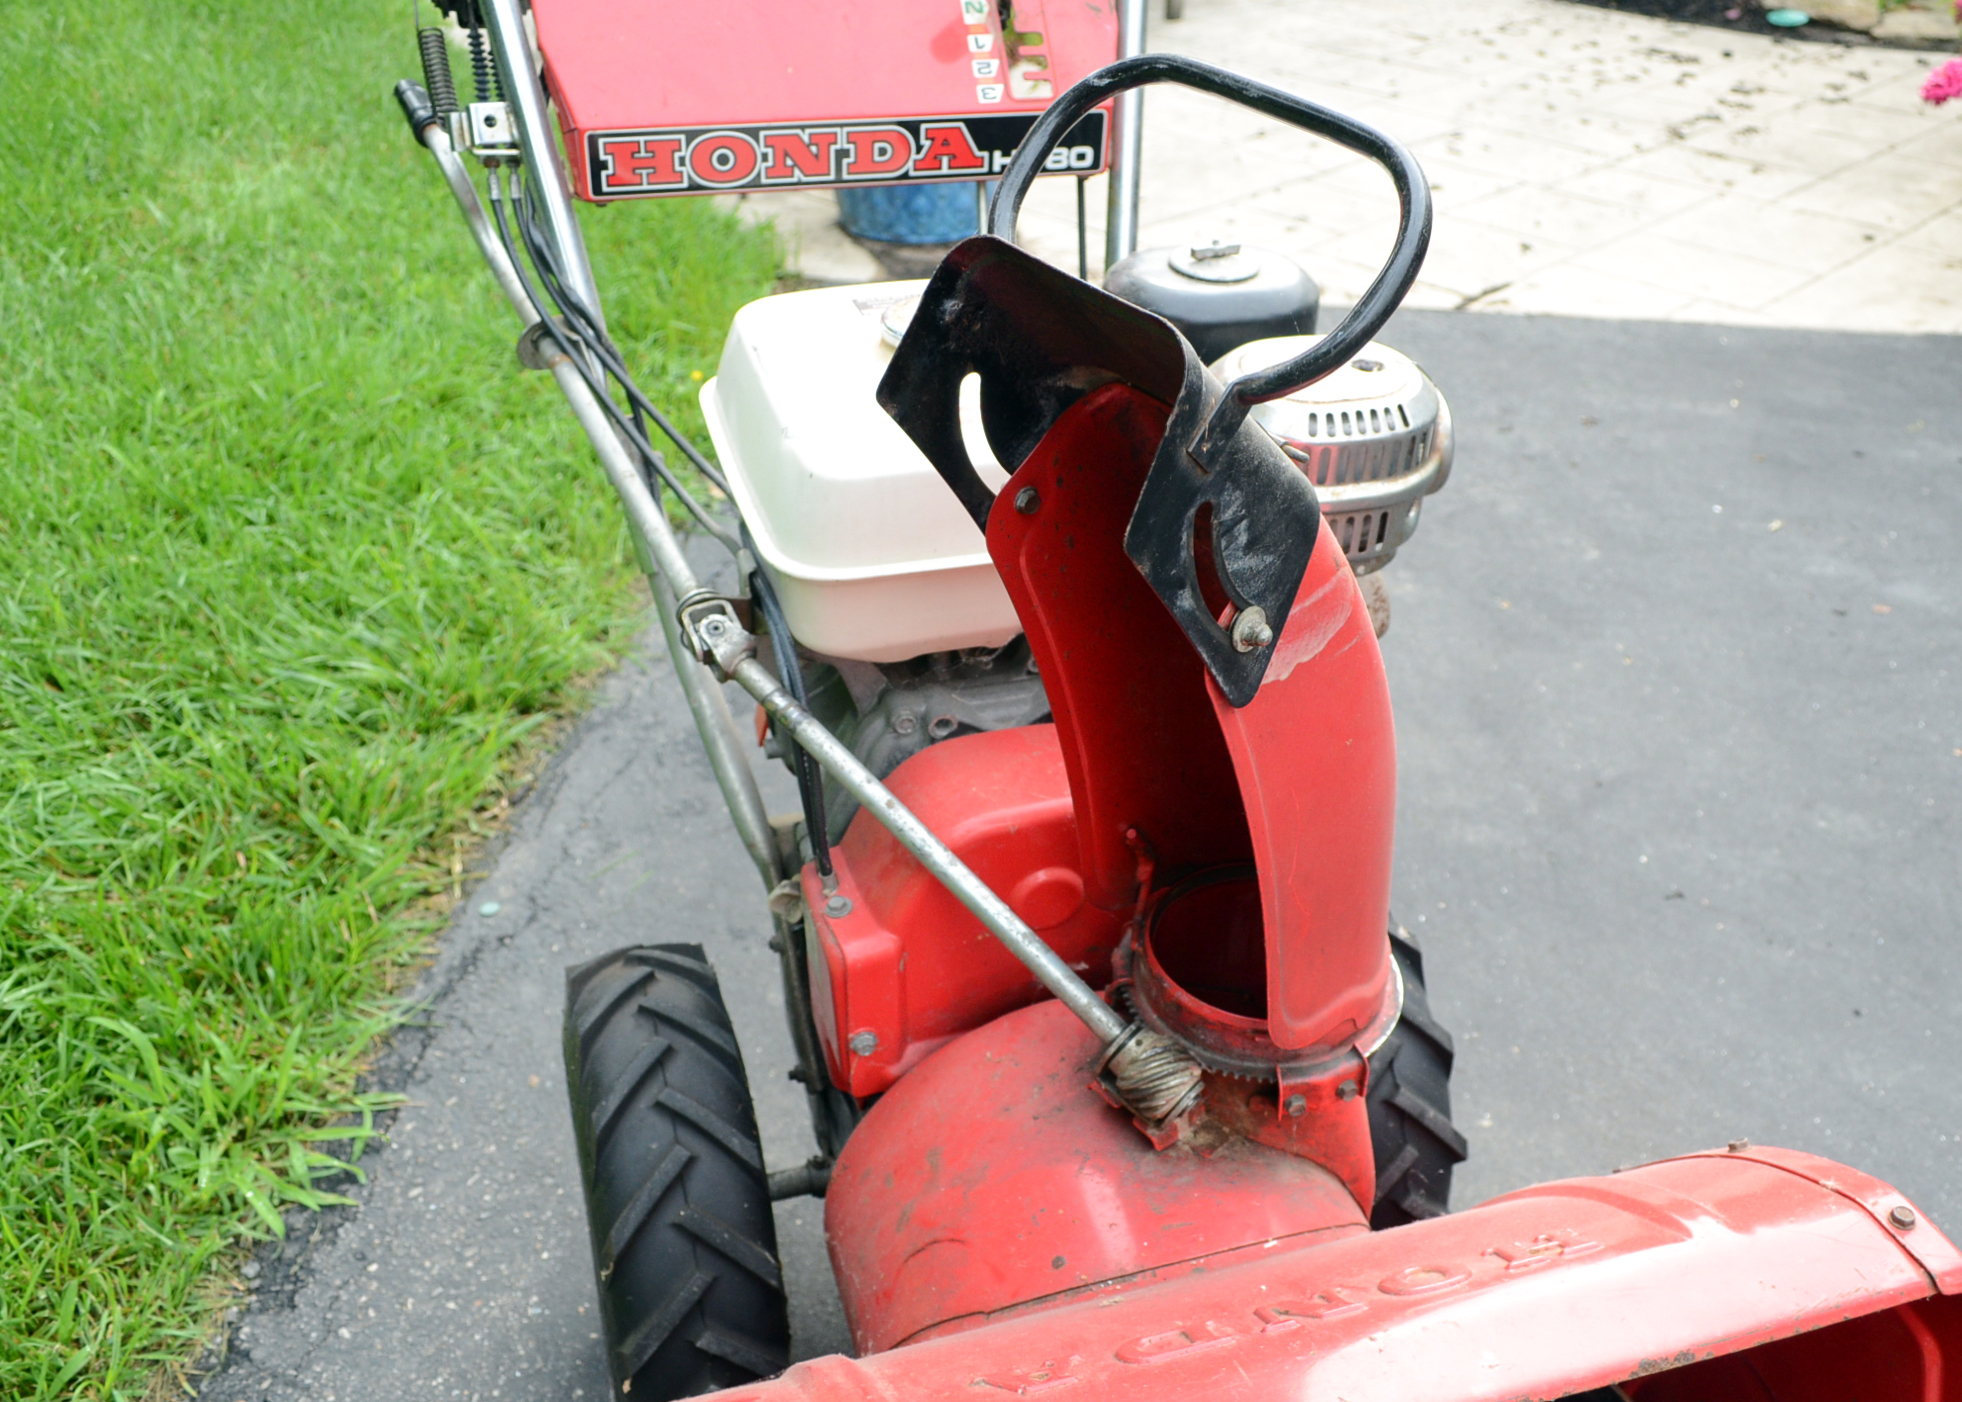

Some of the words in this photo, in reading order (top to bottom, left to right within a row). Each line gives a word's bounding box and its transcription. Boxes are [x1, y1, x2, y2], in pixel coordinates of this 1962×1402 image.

[965, 1, 985, 14] N
[974, 36, 986, 50] 1
[976, 61, 992, 75] 2
[981, 87, 997, 100] 3
[600, 124, 989, 192] HONDA
[992, 145, 1094, 173] H80
[970, 1226, 1603, 1394] HONDA
